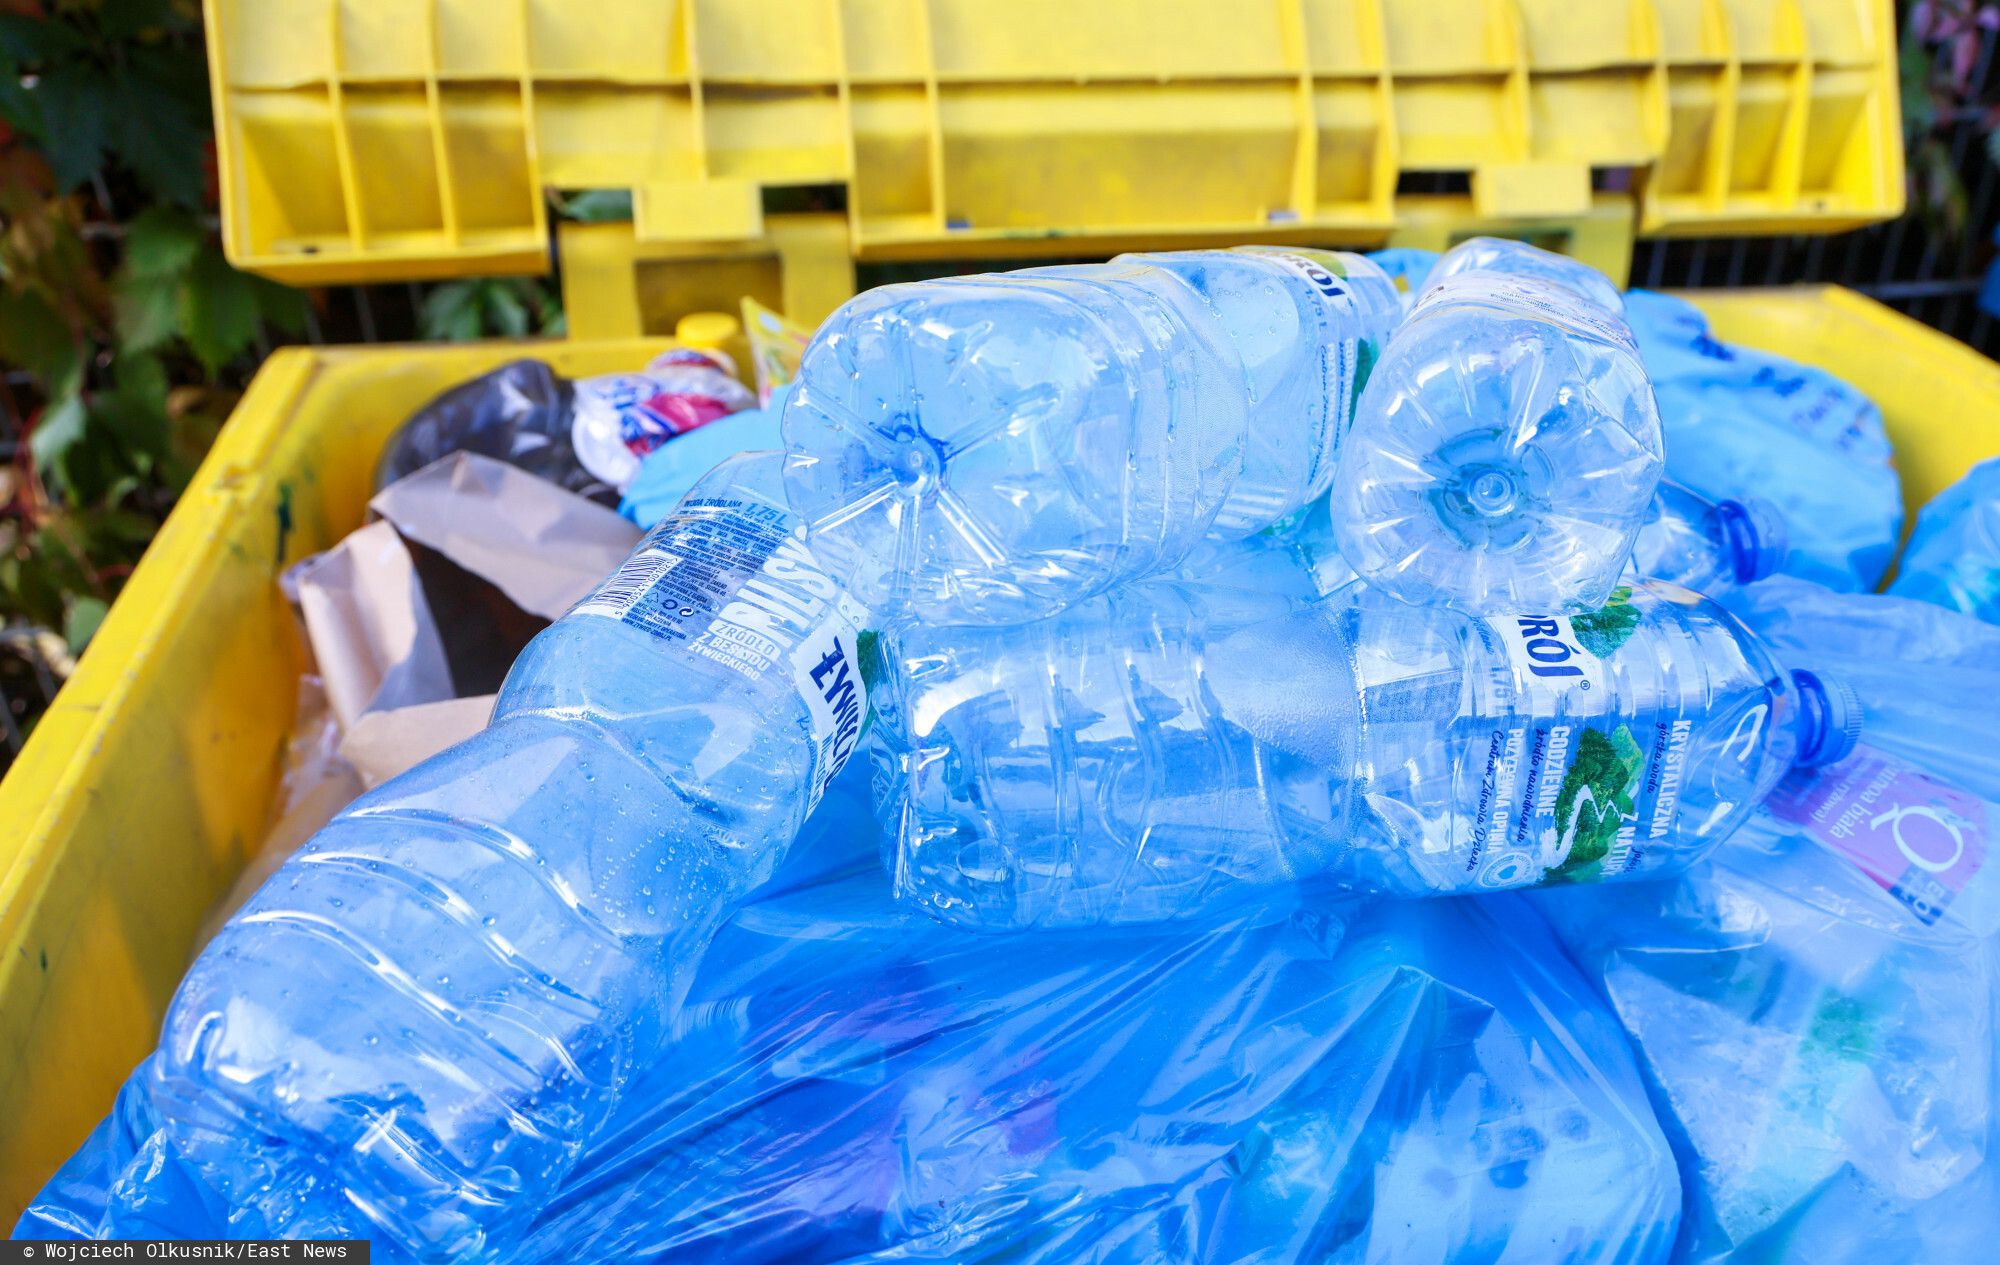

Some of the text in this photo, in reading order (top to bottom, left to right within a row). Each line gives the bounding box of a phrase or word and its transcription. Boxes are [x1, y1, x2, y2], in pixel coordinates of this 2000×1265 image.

[1518, 615, 1585, 678] RÓJ
[1484, 730, 1503, 777] Centrum
[1534, 725, 1569, 818] CODZIENNE
[1645, 721, 1668, 794] górska woda
[1647, 719, 1691, 838] KRYSTALICZNA
[1476, 779, 1494, 825] Zdrowia
[1485, 728, 1524, 854] POZYTYWNA OPINIA
[1514, 768, 1538, 843] nawodnienia
[1619, 811, 1639, 822] Z
